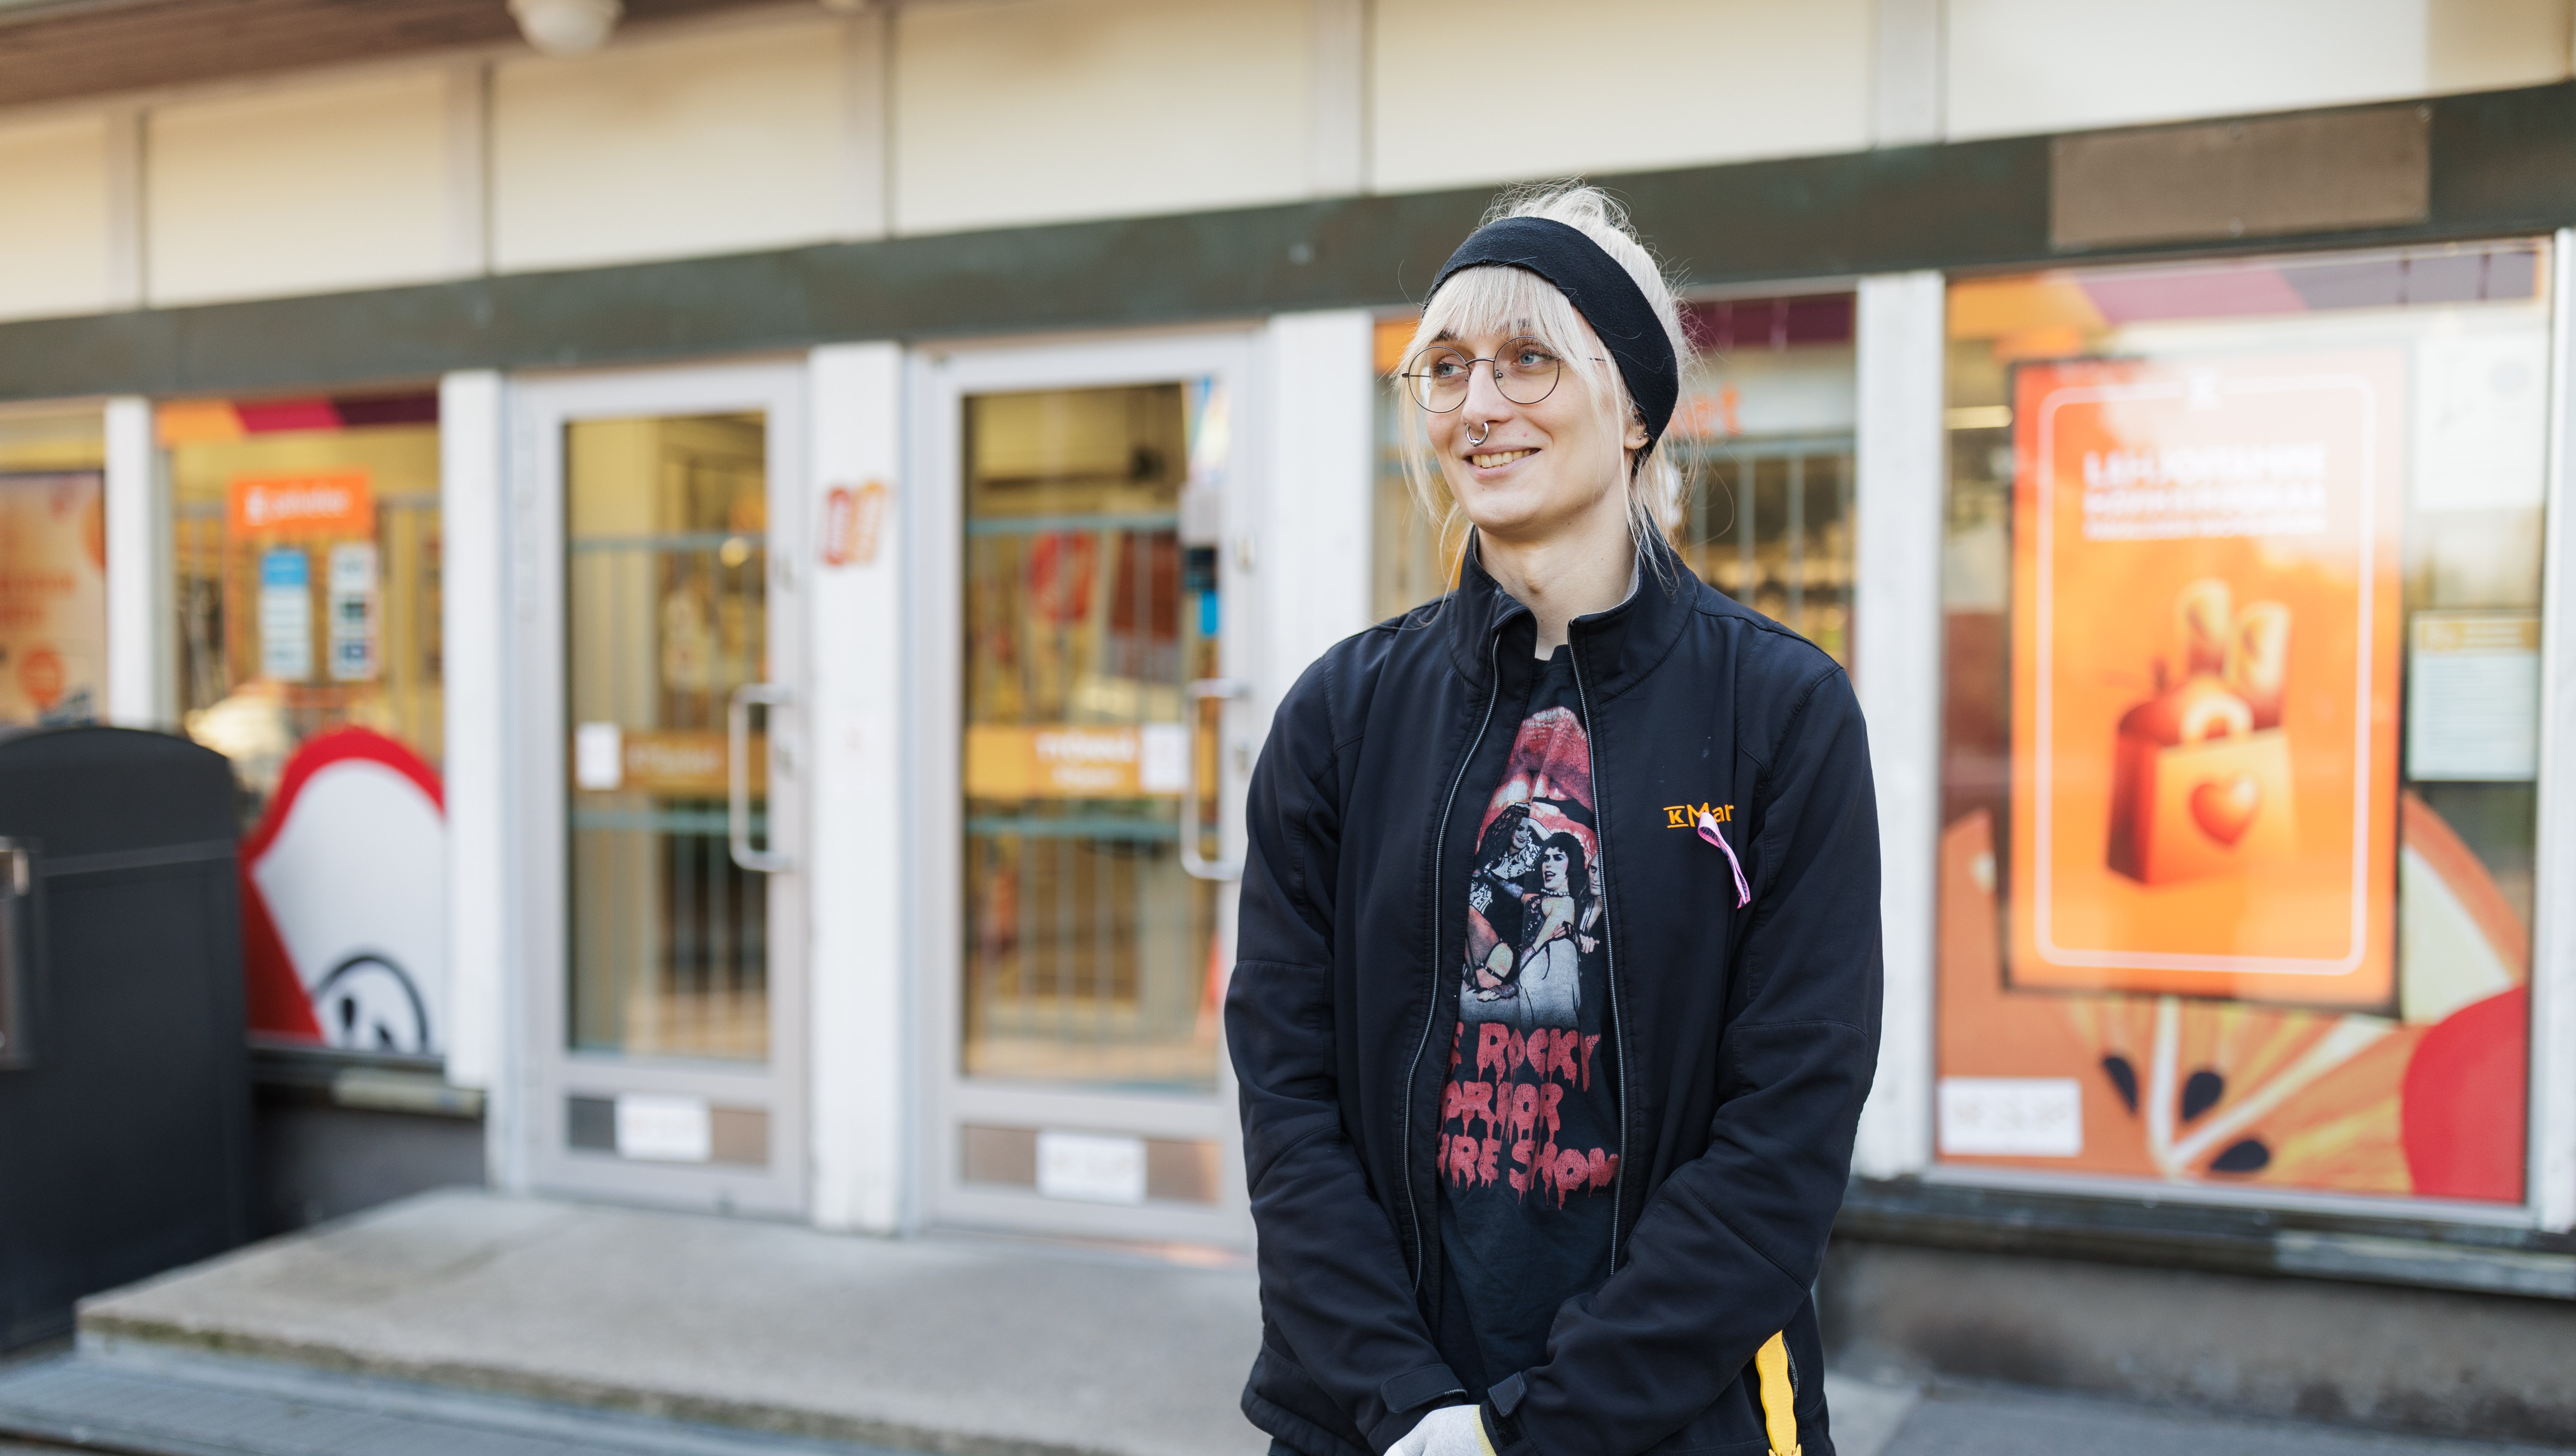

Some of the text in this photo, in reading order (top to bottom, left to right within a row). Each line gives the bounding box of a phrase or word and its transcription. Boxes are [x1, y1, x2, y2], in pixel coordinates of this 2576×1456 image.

[1476, 1022, 1601, 1092] ROCKY
[1438, 1079, 1563, 1144] ORROR
[1509, 1140, 1619, 1210] SHOW
